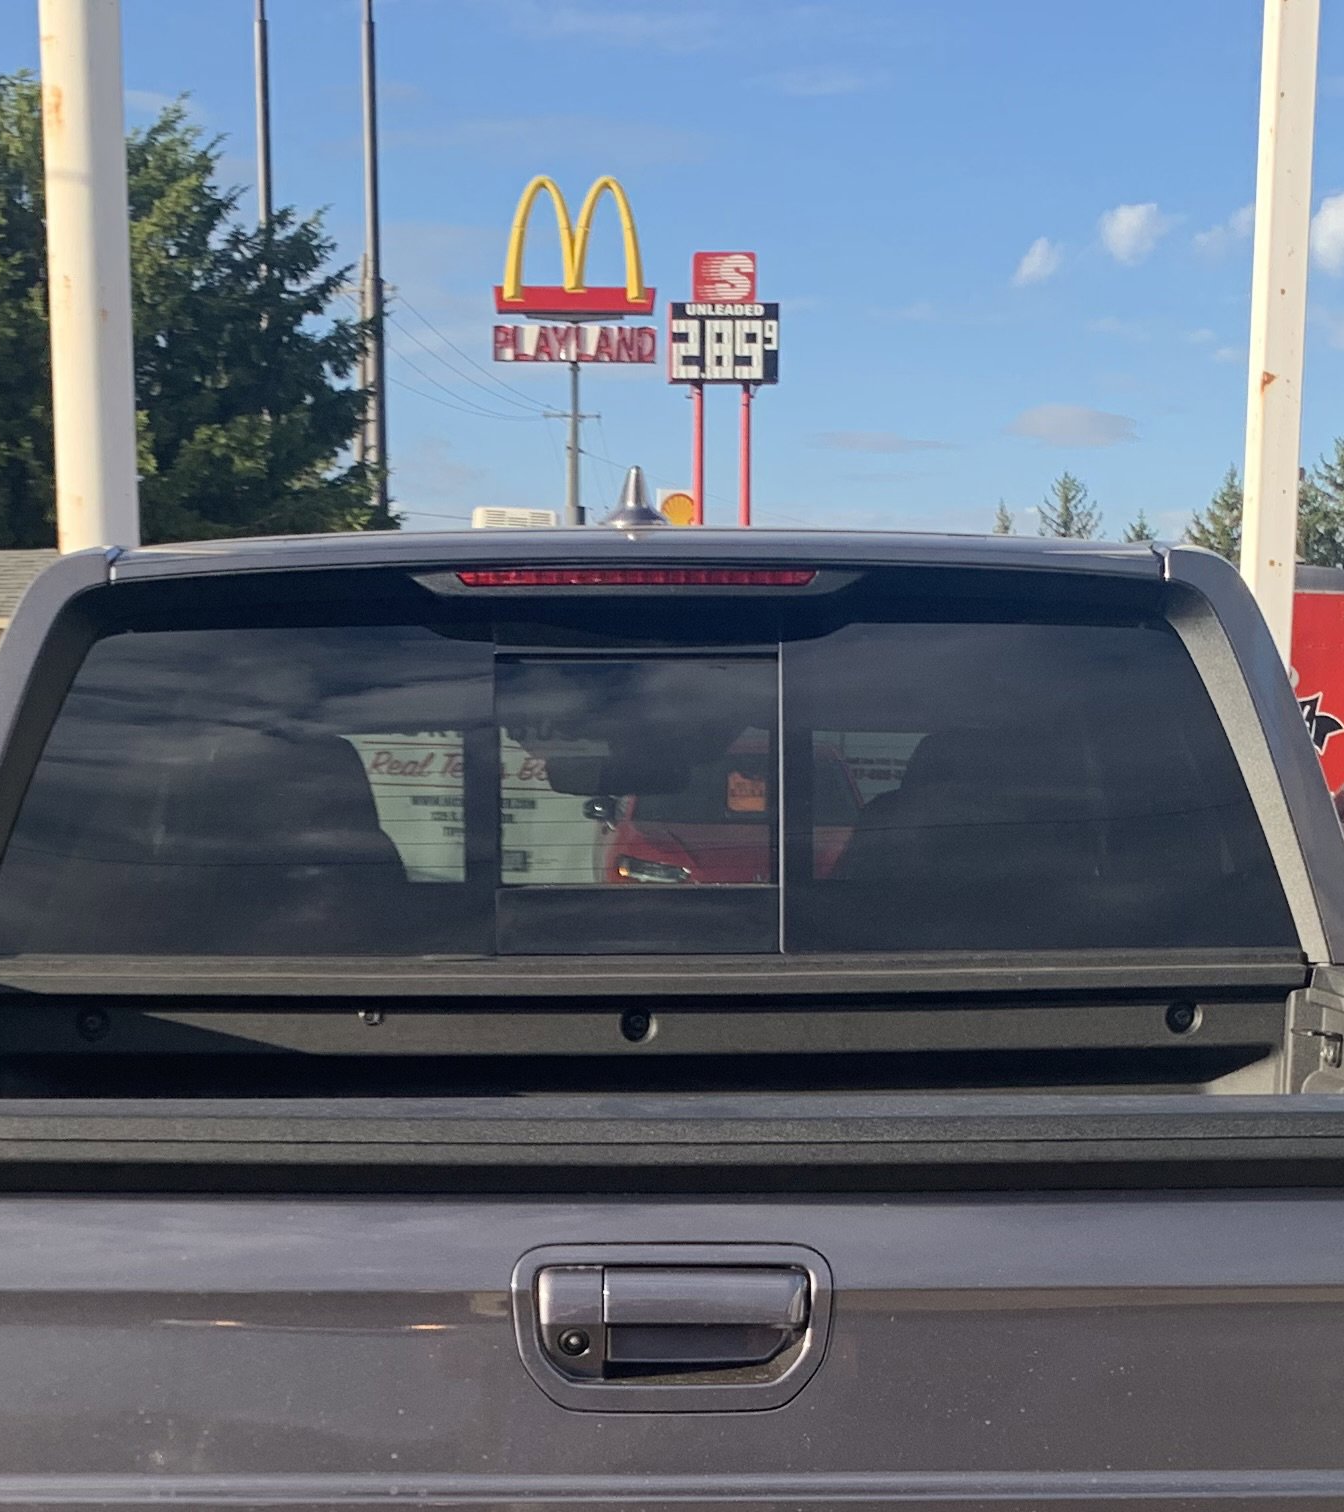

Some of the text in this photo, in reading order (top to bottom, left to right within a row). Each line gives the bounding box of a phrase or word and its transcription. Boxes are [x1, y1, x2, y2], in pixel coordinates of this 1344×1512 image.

[684, 303, 765, 317] UNLEADED
[493, 325, 657, 363] PLAYLAND
[369, 750, 435, 777] Real
